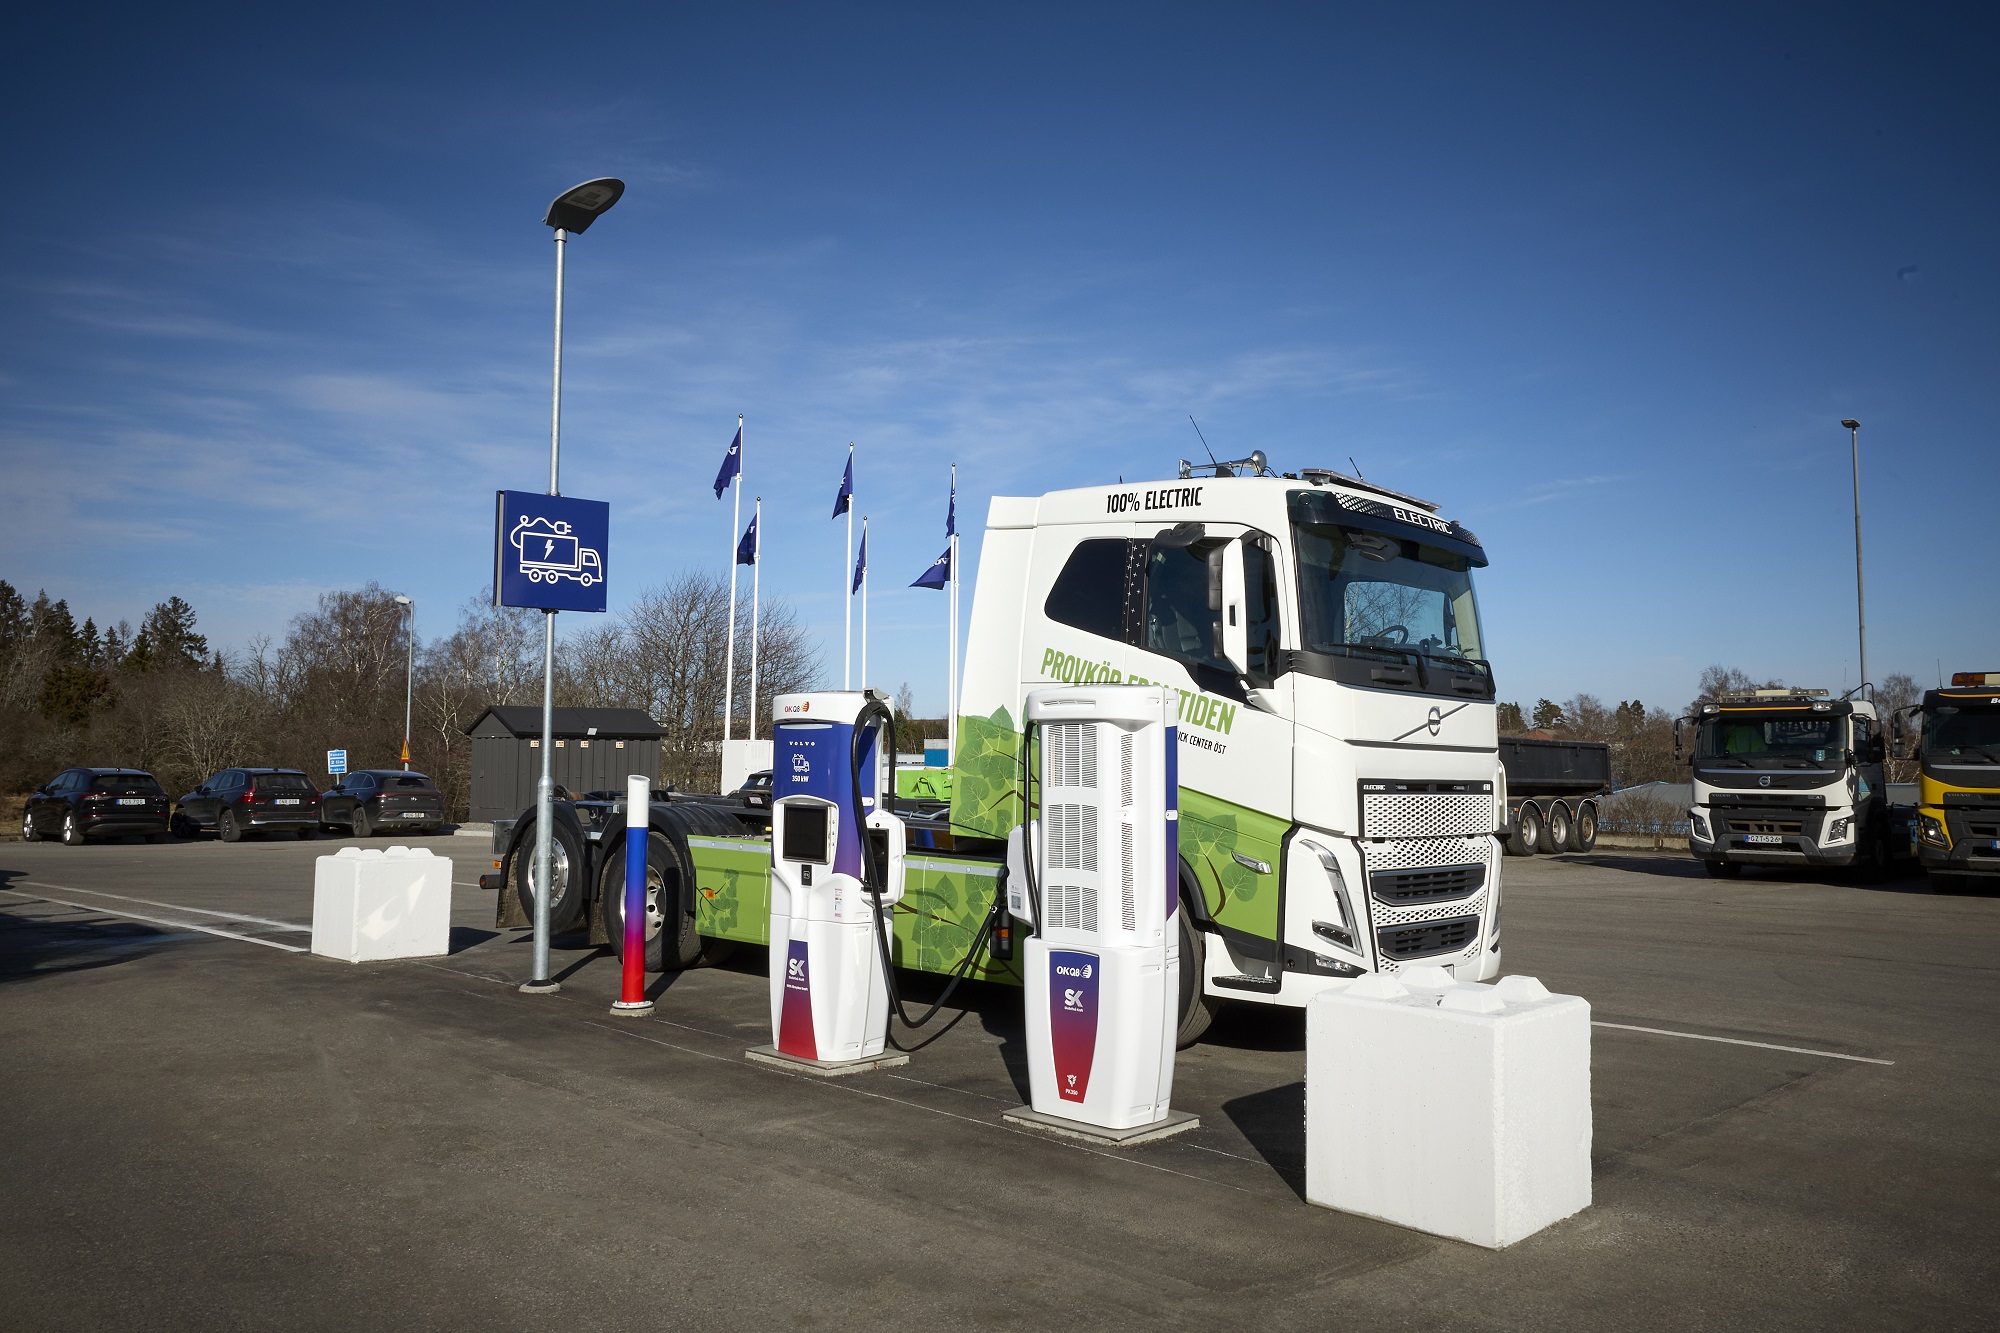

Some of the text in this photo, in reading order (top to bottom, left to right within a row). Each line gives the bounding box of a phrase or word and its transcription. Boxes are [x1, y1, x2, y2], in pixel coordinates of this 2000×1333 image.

[1106, 486, 1203, 513] 100% ELECTRIC
[1393, 507, 1452, 535] ELECTRIC
[1189, 734, 1213, 751] CENTER
[1213, 740, 1227, 755] ÖST
[788, 958, 805, 977] SK
[1056, 965, 1080, 977] OKQ8
[1064, 988, 1084, 1008] SK
